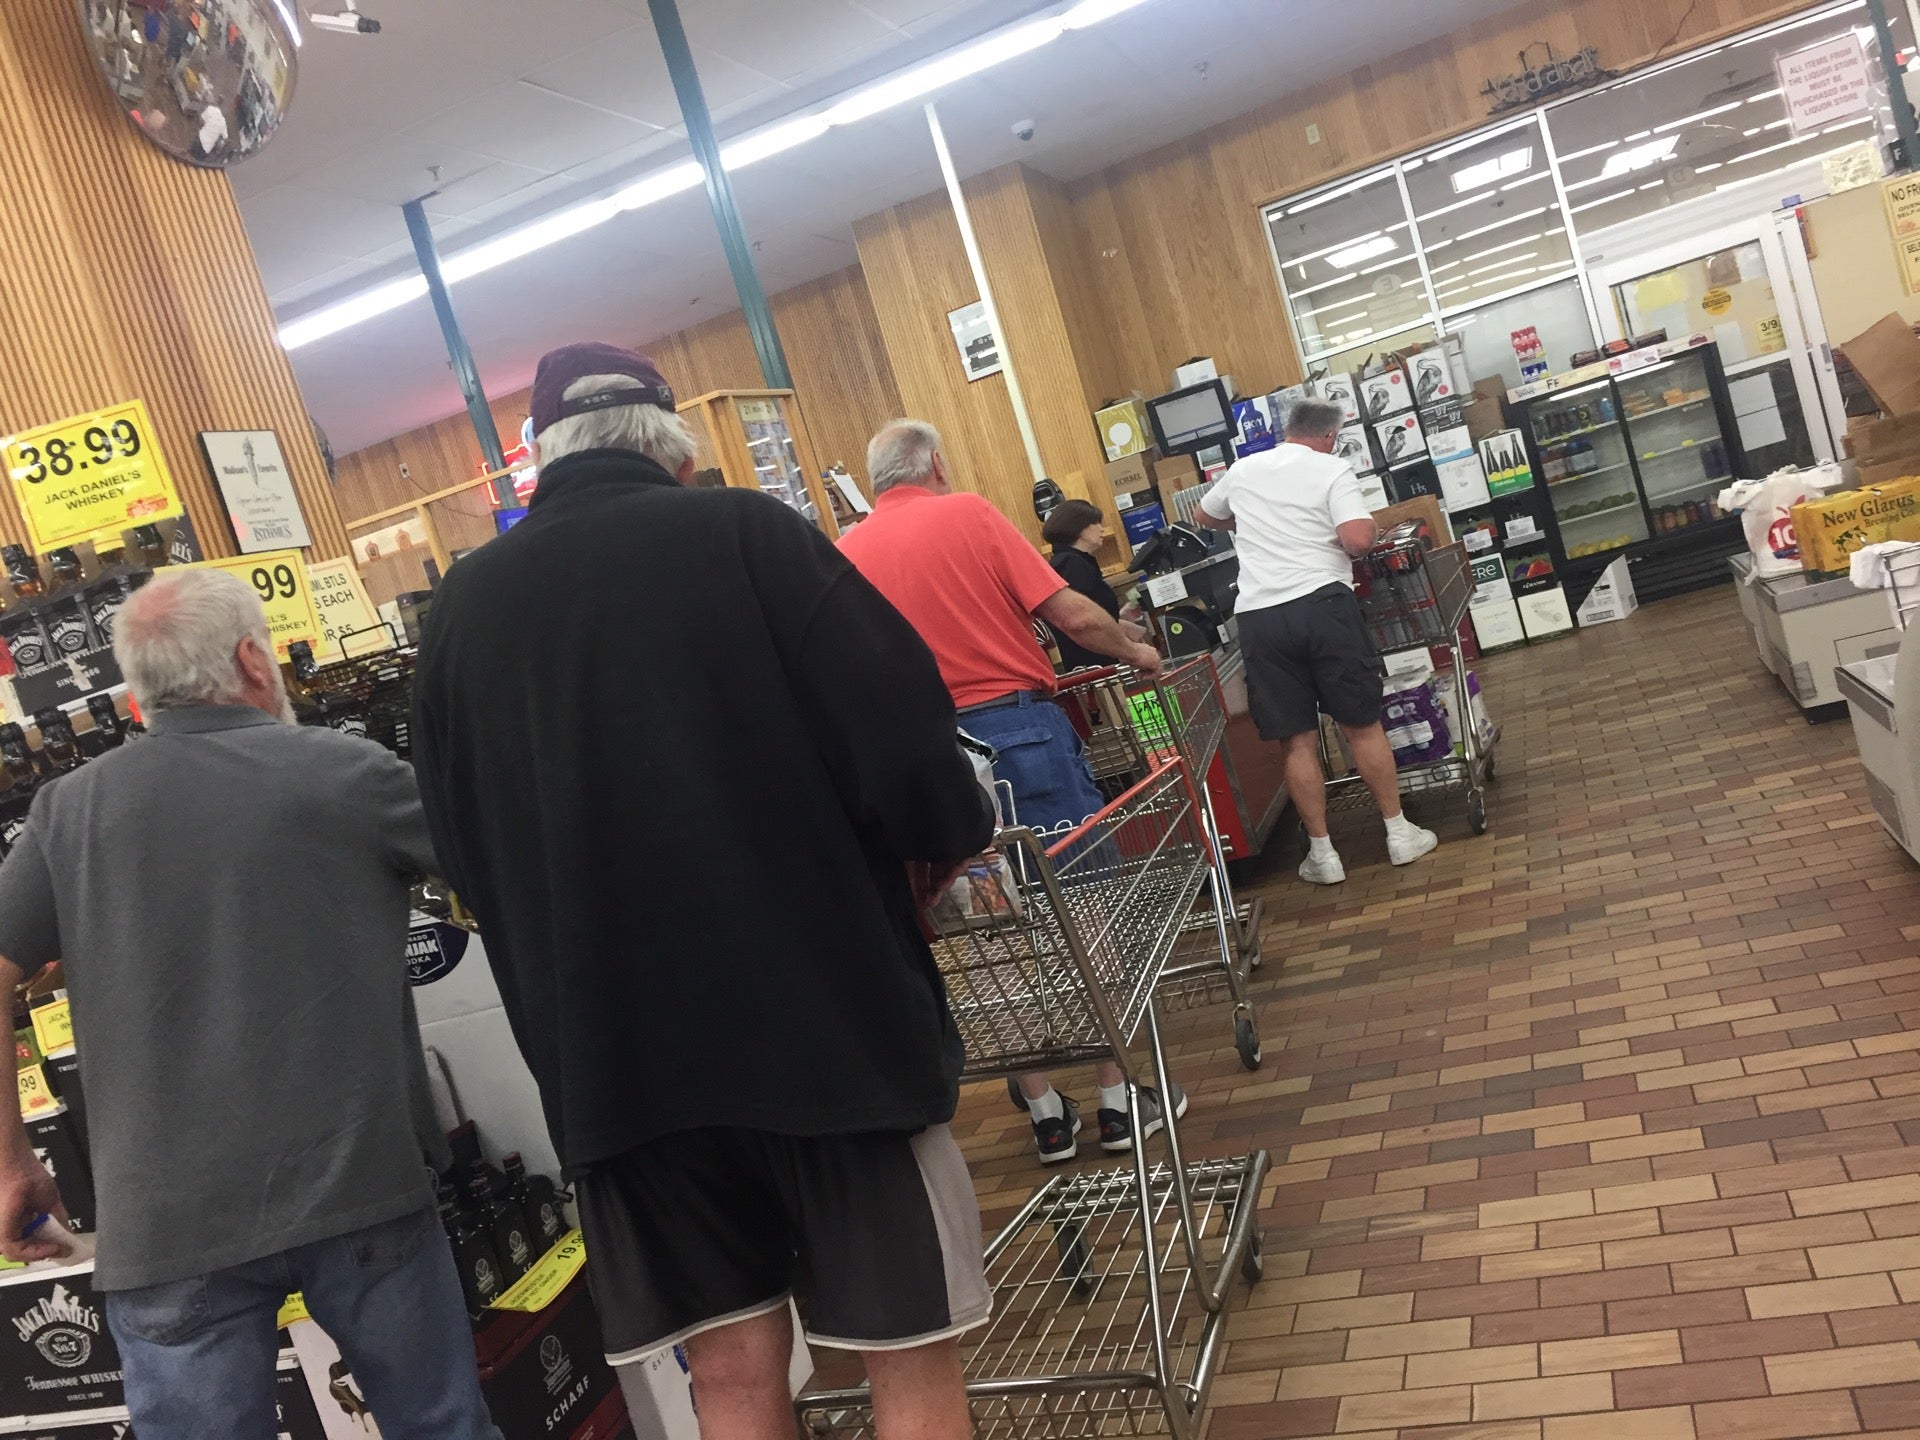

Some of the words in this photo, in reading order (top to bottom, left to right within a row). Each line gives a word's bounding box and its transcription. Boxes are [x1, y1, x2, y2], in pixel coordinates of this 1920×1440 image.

[1790, 65, 1802, 75] ALL
[1805, 55, 1827, 69] ITEMS
[1830, 47, 1851, 60] FROM
[1789, 77, 1802, 86] THE
[1805, 65, 1832, 81] LIQUOR
[1834, 57, 1858, 71] STORE
[1809, 78, 1830, 90] MUST
[1832, 74, 1842, 83] BE
[1793, 87, 1838, 108] PURCHASED
[1840, 84, 1848, 92] IN
[1850, 78, 1864, 88] THE
[1805, 101, 1832, 116] LIQUOR
[1834, 92, 1858, 105] STORE
[1891, 188, 1905, 202] NO
[1242, 417, 1264, 431] SKYY
[19, 419, 141, 484] 38.99
[44, 487, 78, 505] JACK
[80, 469, 141, 494] DANIEL'S
[1114, 472, 1142, 486] KORBEL
[65, 487, 126, 510] WHISKEY
[1822, 507, 1858, 528] New
[1860, 494, 1915, 518] Glarus
[1864, 510, 1900, 528] Brewing
[253, 525, 293, 541] ISTHMUS
[325, 573, 347, 589] BTLS
[323, 590, 355, 607] EACH
[12, 1305, 47, 1343] JACK
[38, 1297, 100, 1336] DANIEL'S
[25, 1375, 79, 1391] Tennessee
